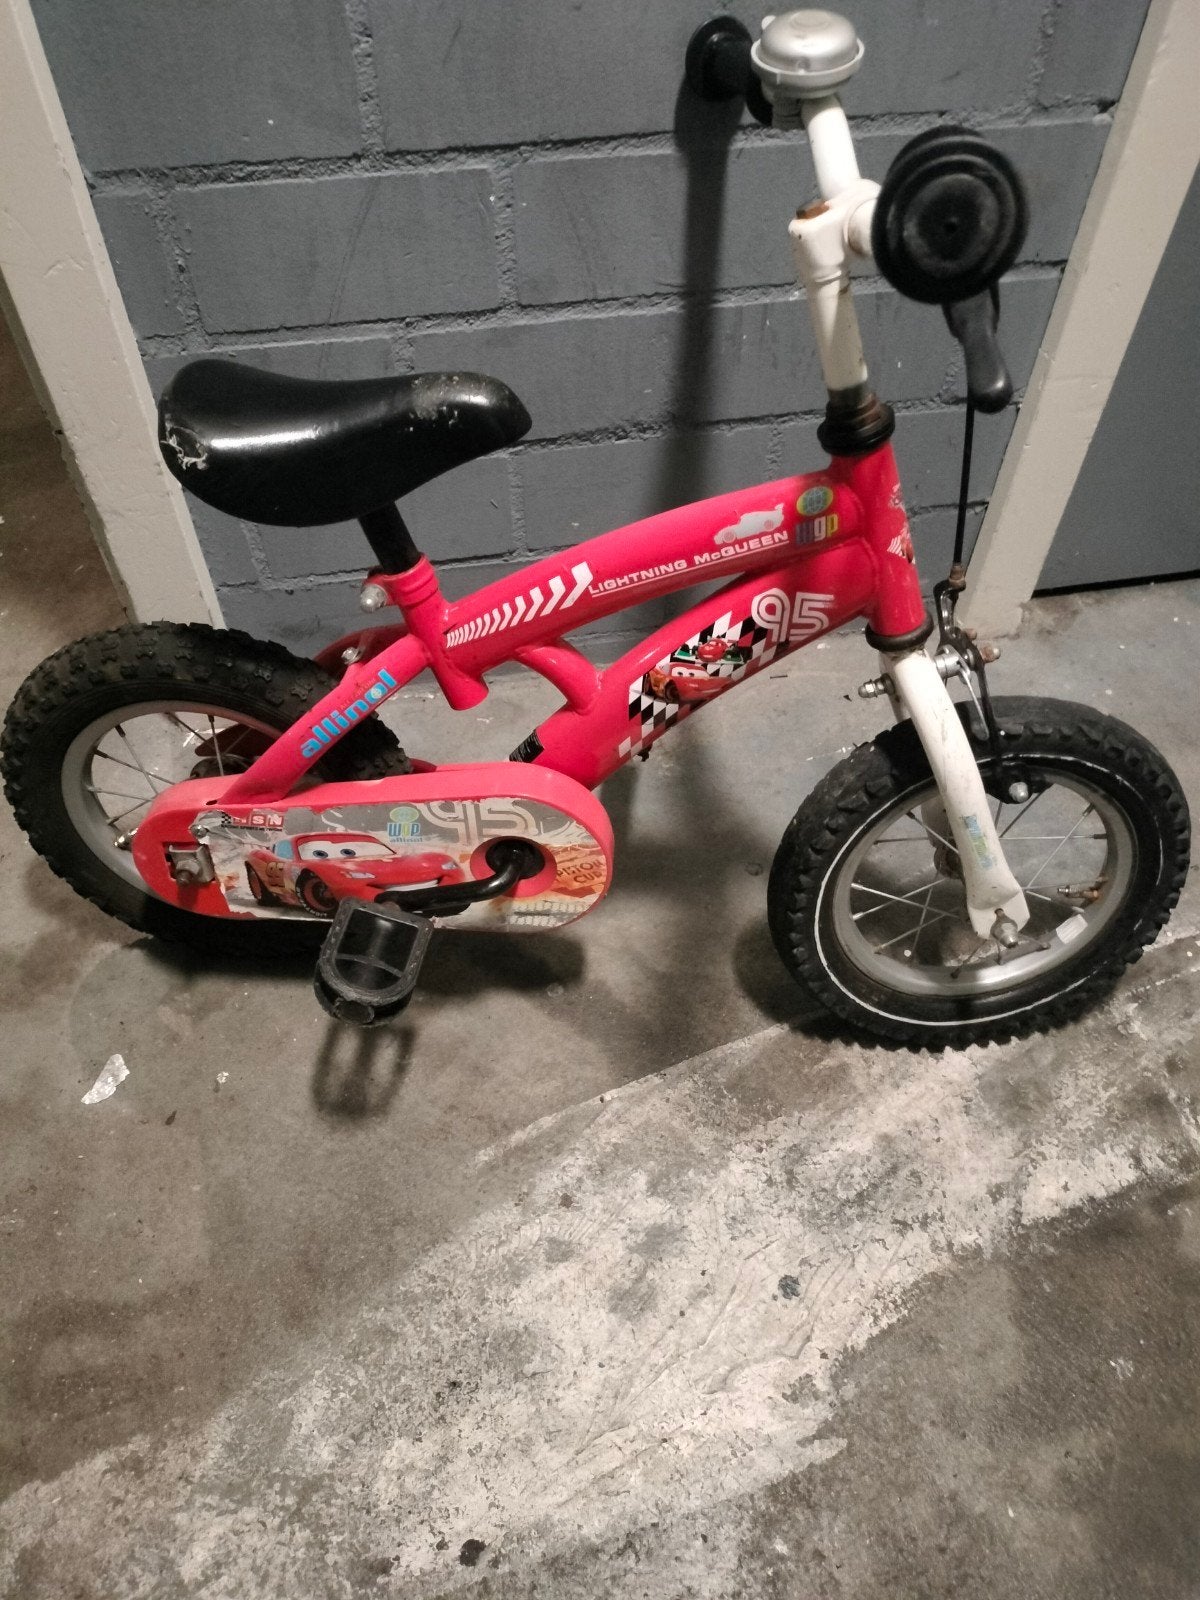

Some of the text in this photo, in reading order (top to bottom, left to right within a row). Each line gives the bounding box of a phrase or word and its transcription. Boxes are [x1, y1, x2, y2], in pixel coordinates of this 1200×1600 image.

[588, 530, 789, 594] LIGHTNING McQUEEN
[751, 587, 836, 643] 95
[301, 668, 397, 758] allinol
